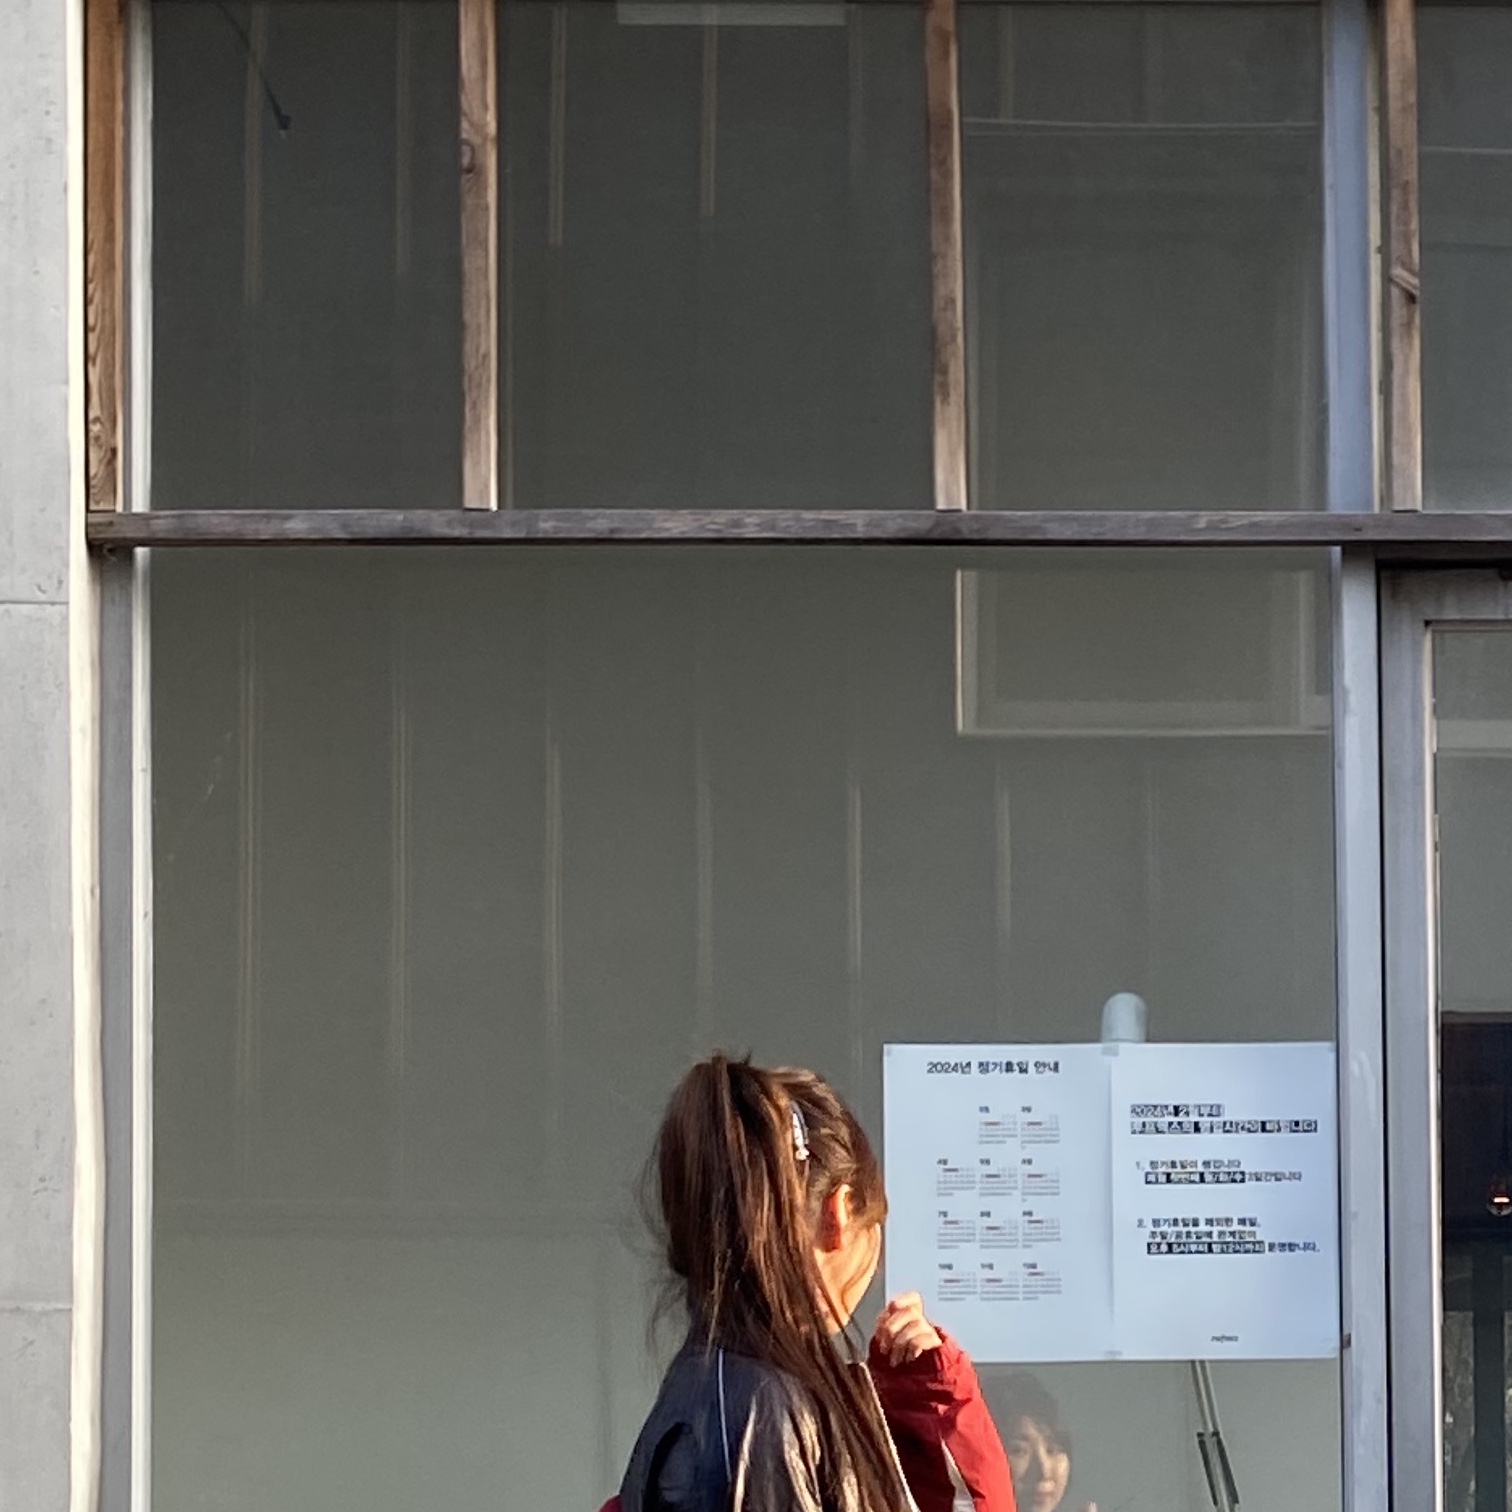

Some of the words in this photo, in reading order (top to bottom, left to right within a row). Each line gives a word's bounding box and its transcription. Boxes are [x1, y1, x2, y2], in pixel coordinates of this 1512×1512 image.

[927, 1061, 971, 1075] 2024년
[978, 1061, 1028, 1075] 정기휴일
[1033, 1061, 1059, 1075] 안내
